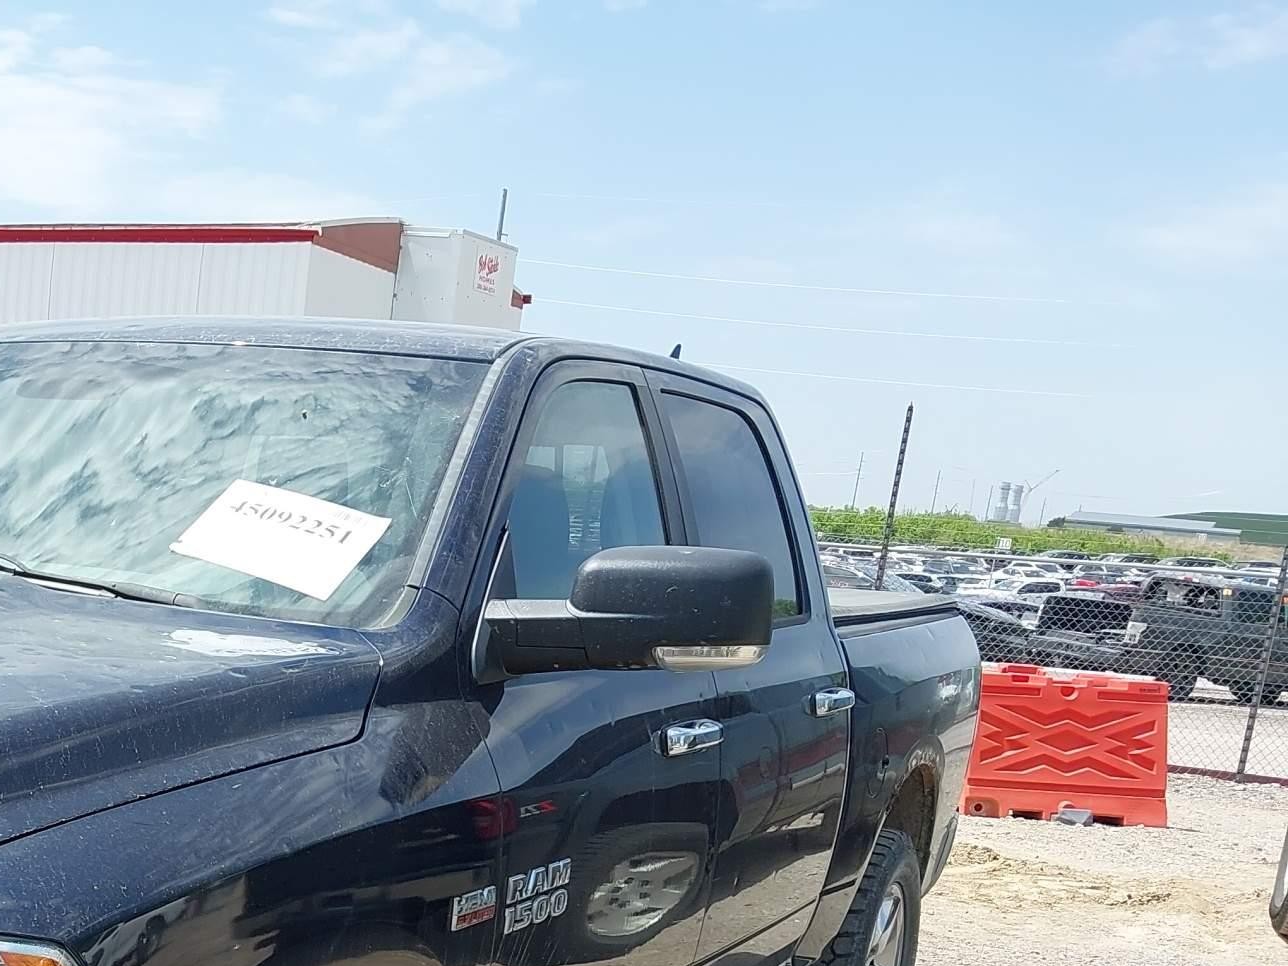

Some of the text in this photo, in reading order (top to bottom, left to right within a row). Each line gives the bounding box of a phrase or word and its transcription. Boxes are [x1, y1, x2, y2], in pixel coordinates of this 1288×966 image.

[230, 500, 352, 544] 45092251
[506, 857, 572, 905] RAM
[504, 888, 569, 935] 1500
